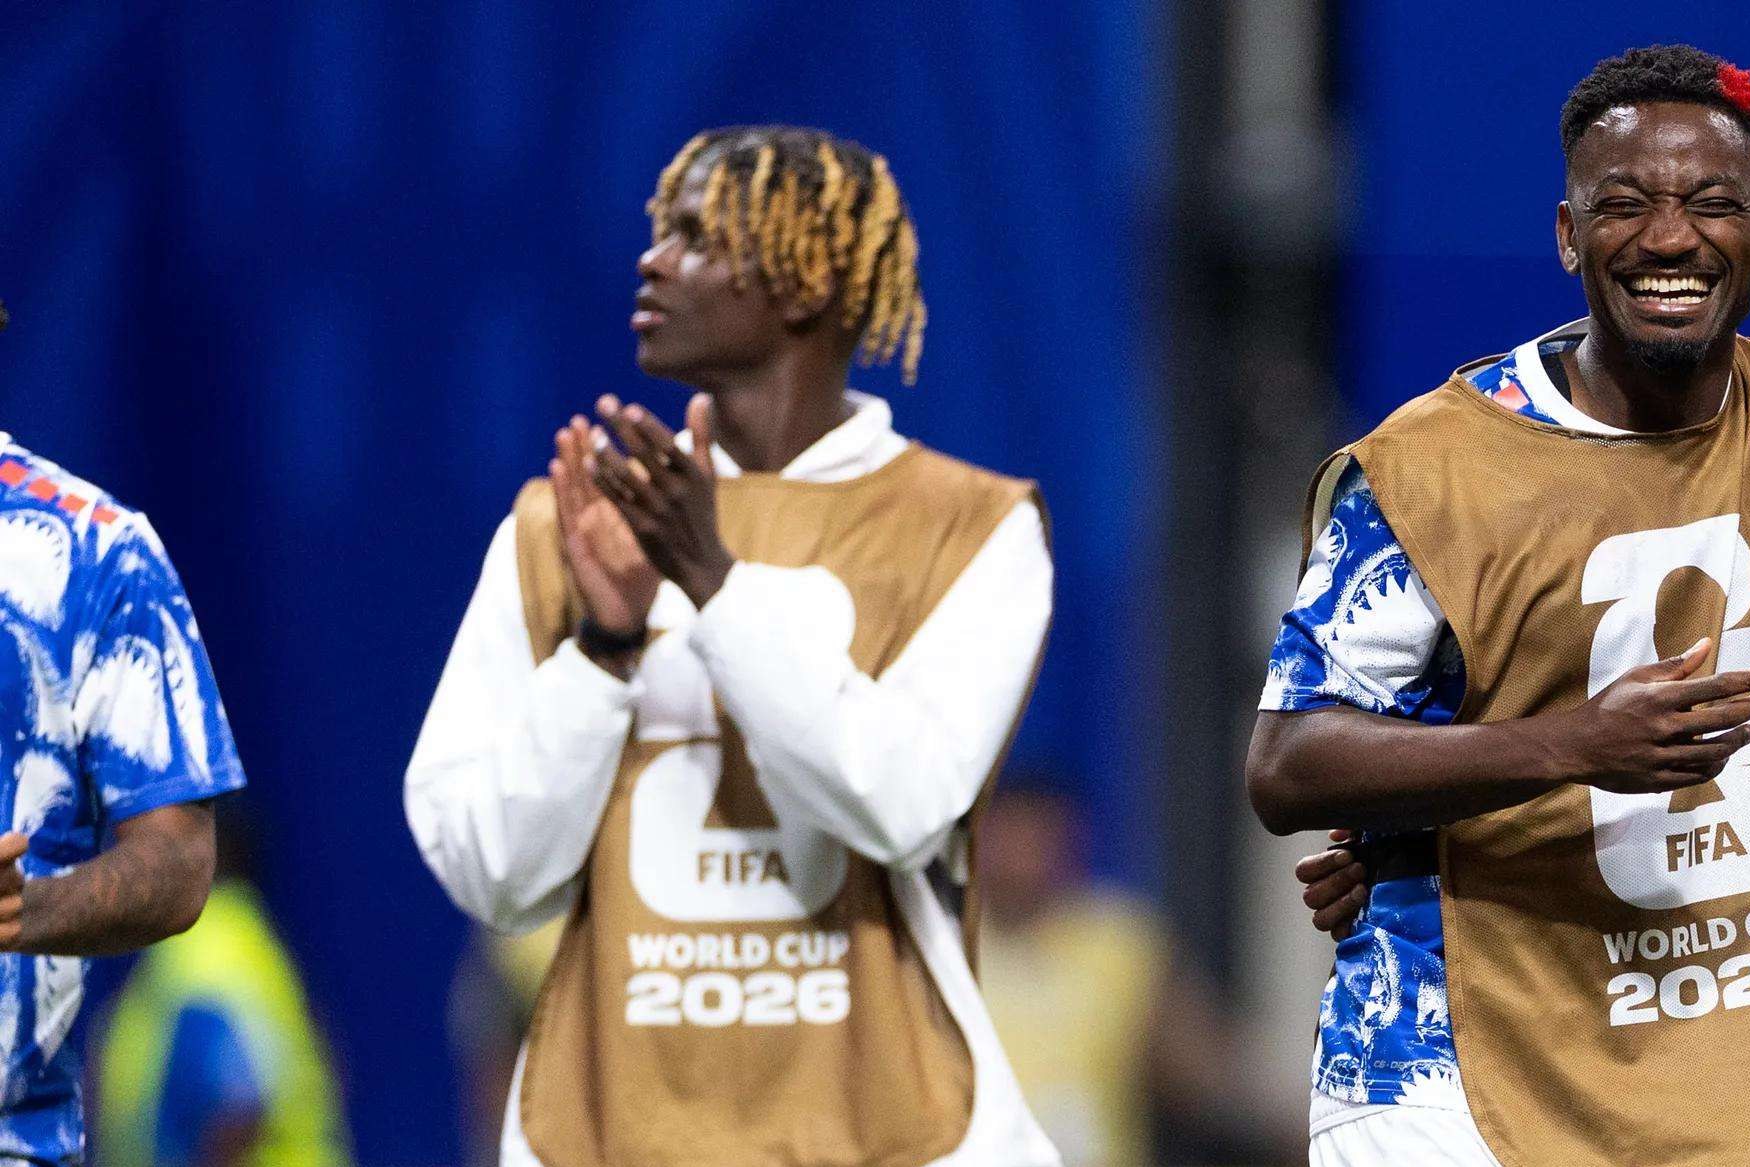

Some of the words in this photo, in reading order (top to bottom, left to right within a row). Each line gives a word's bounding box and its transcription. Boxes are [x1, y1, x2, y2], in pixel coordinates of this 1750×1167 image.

[696, 851, 790, 884] FIFA
[1665, 821, 1748, 872] FIFA
[626, 932, 772, 969] WORLD
[774, 931, 850, 968] CUP
[1602, 917, 1738, 964] WORLD
[624, 968, 851, 1027] 2026
